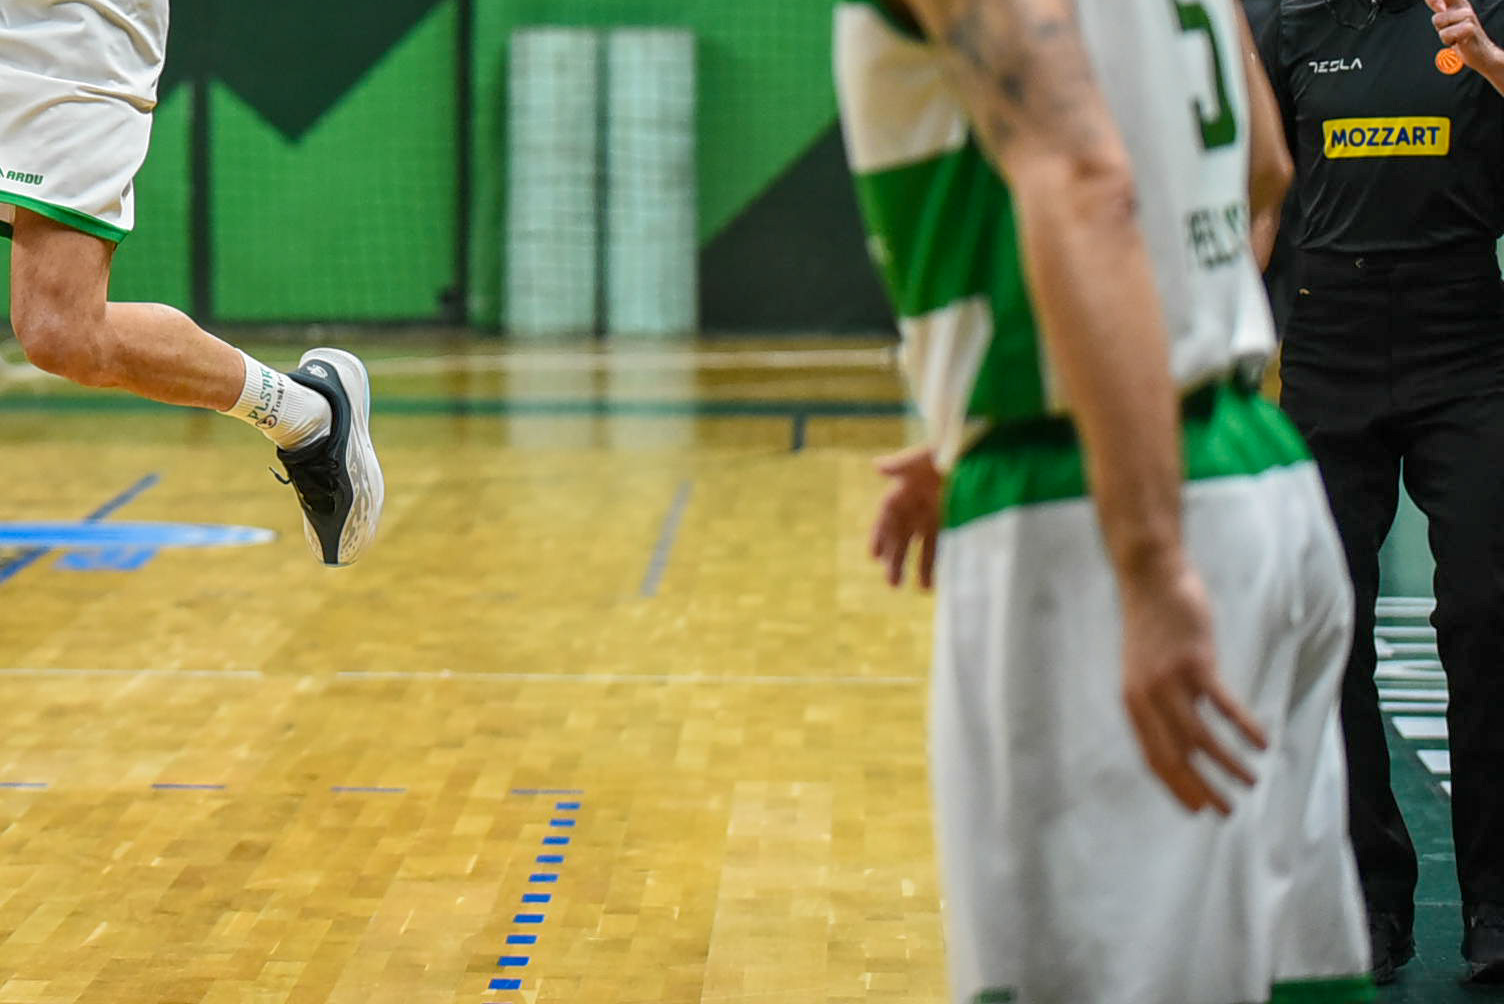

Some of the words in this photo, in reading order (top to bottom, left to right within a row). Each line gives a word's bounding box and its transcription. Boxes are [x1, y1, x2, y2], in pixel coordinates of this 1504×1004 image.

[1308, 57, 1363, 73] TESLA
[1331, 126, 1441, 148] MOZZART
[6, 170, 44, 186] ARDU
